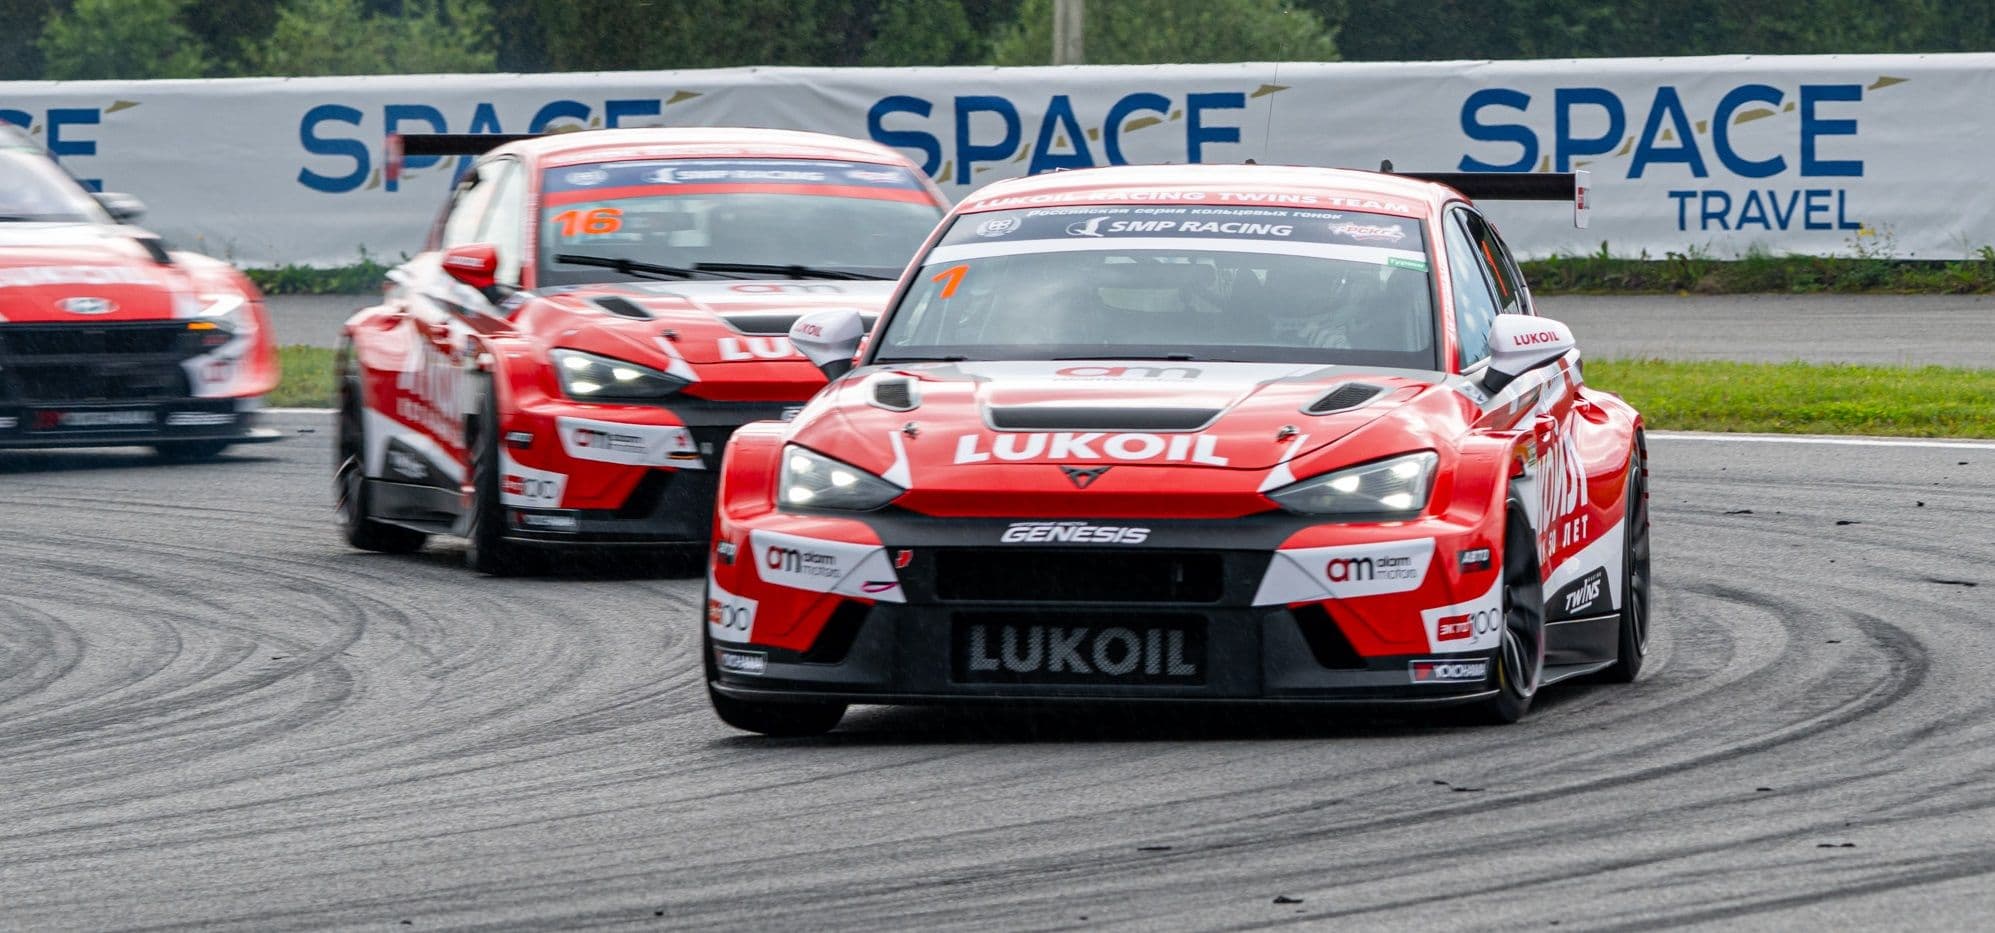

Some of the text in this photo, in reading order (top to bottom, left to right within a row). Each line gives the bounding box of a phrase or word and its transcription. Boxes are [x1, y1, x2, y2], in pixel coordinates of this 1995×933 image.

[297, 100, 661, 193] SPA
[1458, 84, 1865, 178] SPACE
[1220, 192, 1319, 204] TWINS
[1328, 198, 1409, 213] TEAM
[1669, 190, 1862, 231] TRAVEL
[552, 207, 624, 238] 16
[1107, 220, 1294, 237] SMP RACING
[931, 263, 971, 300] 1
[717, 336, 806, 361] LU
[1513, 331, 1561, 347] LUKOIL
[953, 432, 1230, 468] LUKOIL
[1000, 526, 1152, 544] GENESIS
[1562, 513, 1588, 549] ЛЕТ
[1326, 556, 1375, 582] am
[1565, 578, 1601, 611] TWINS
[967, 624, 1198, 677] LUKOIL
